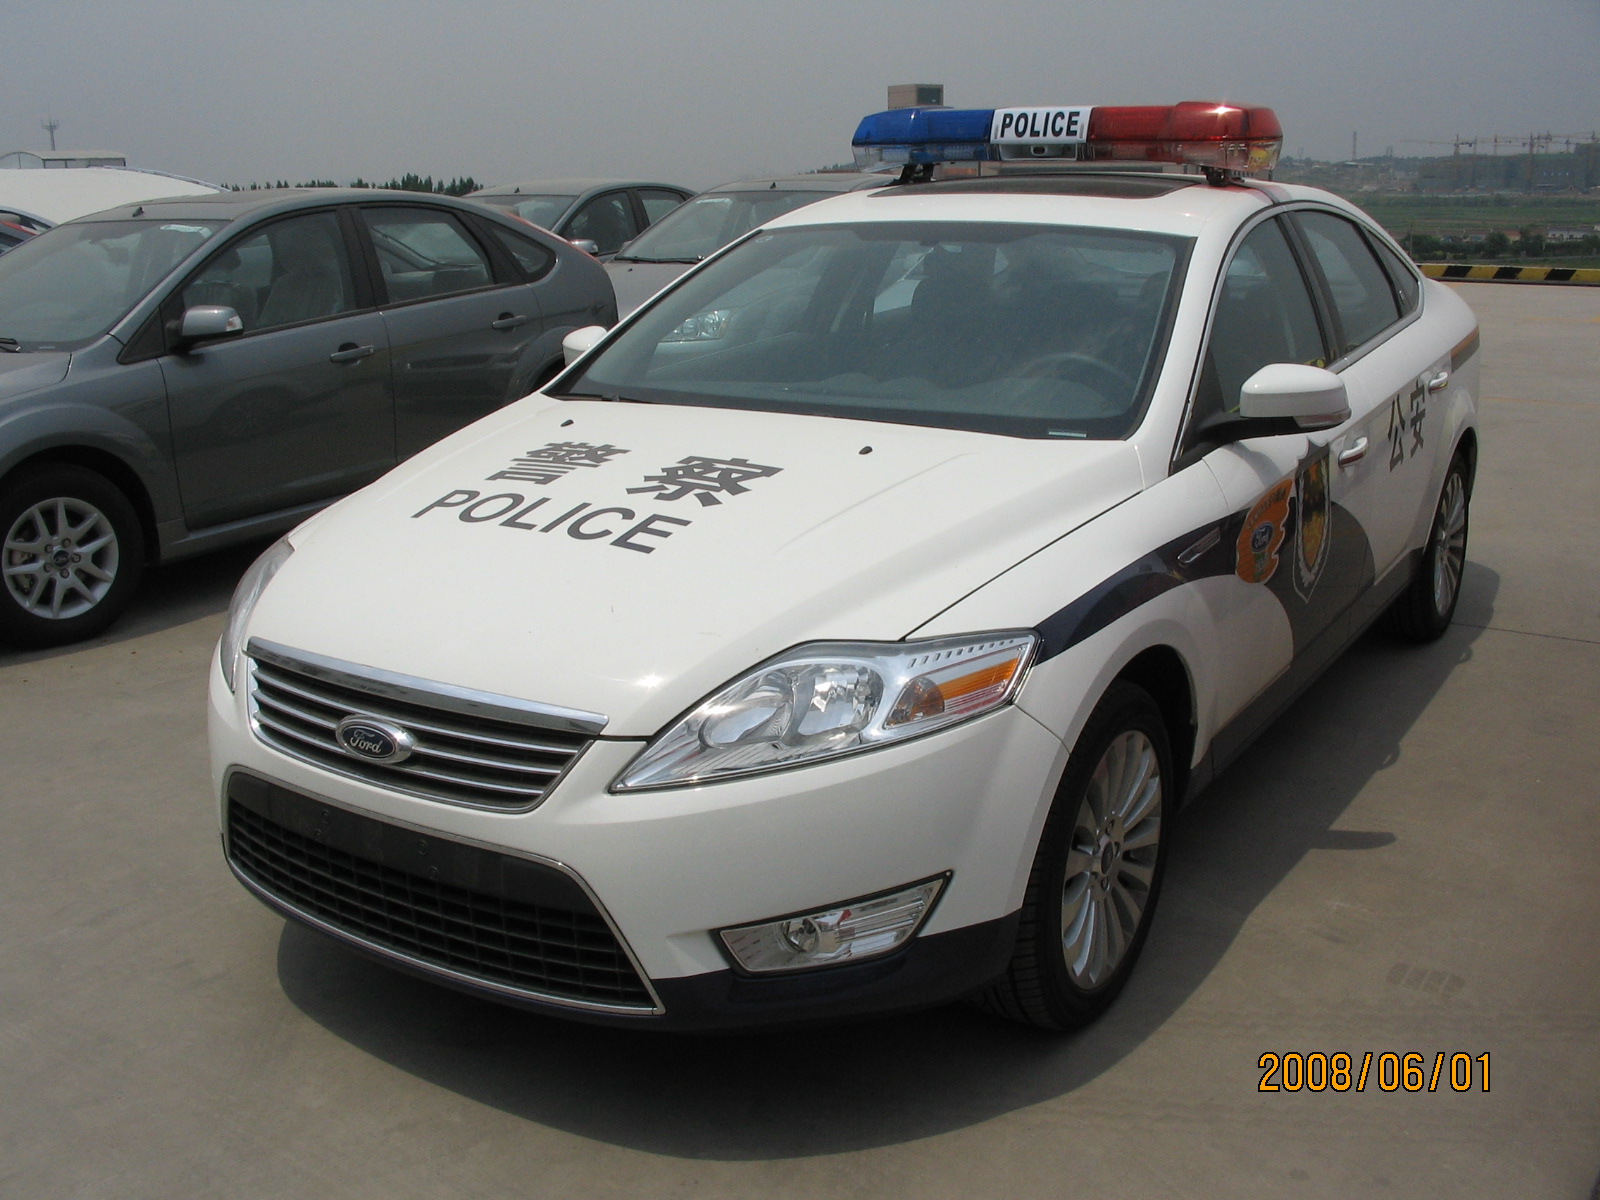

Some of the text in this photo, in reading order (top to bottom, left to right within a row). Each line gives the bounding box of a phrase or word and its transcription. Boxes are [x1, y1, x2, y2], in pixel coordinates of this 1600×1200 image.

[1000, 111, 1081, 138] POLICE
[1387, 379, 1426, 473] 公安
[484, 441, 785, 508] 警察
[410, 489, 693, 554] POLICE
[349, 728, 383, 753] Ford
